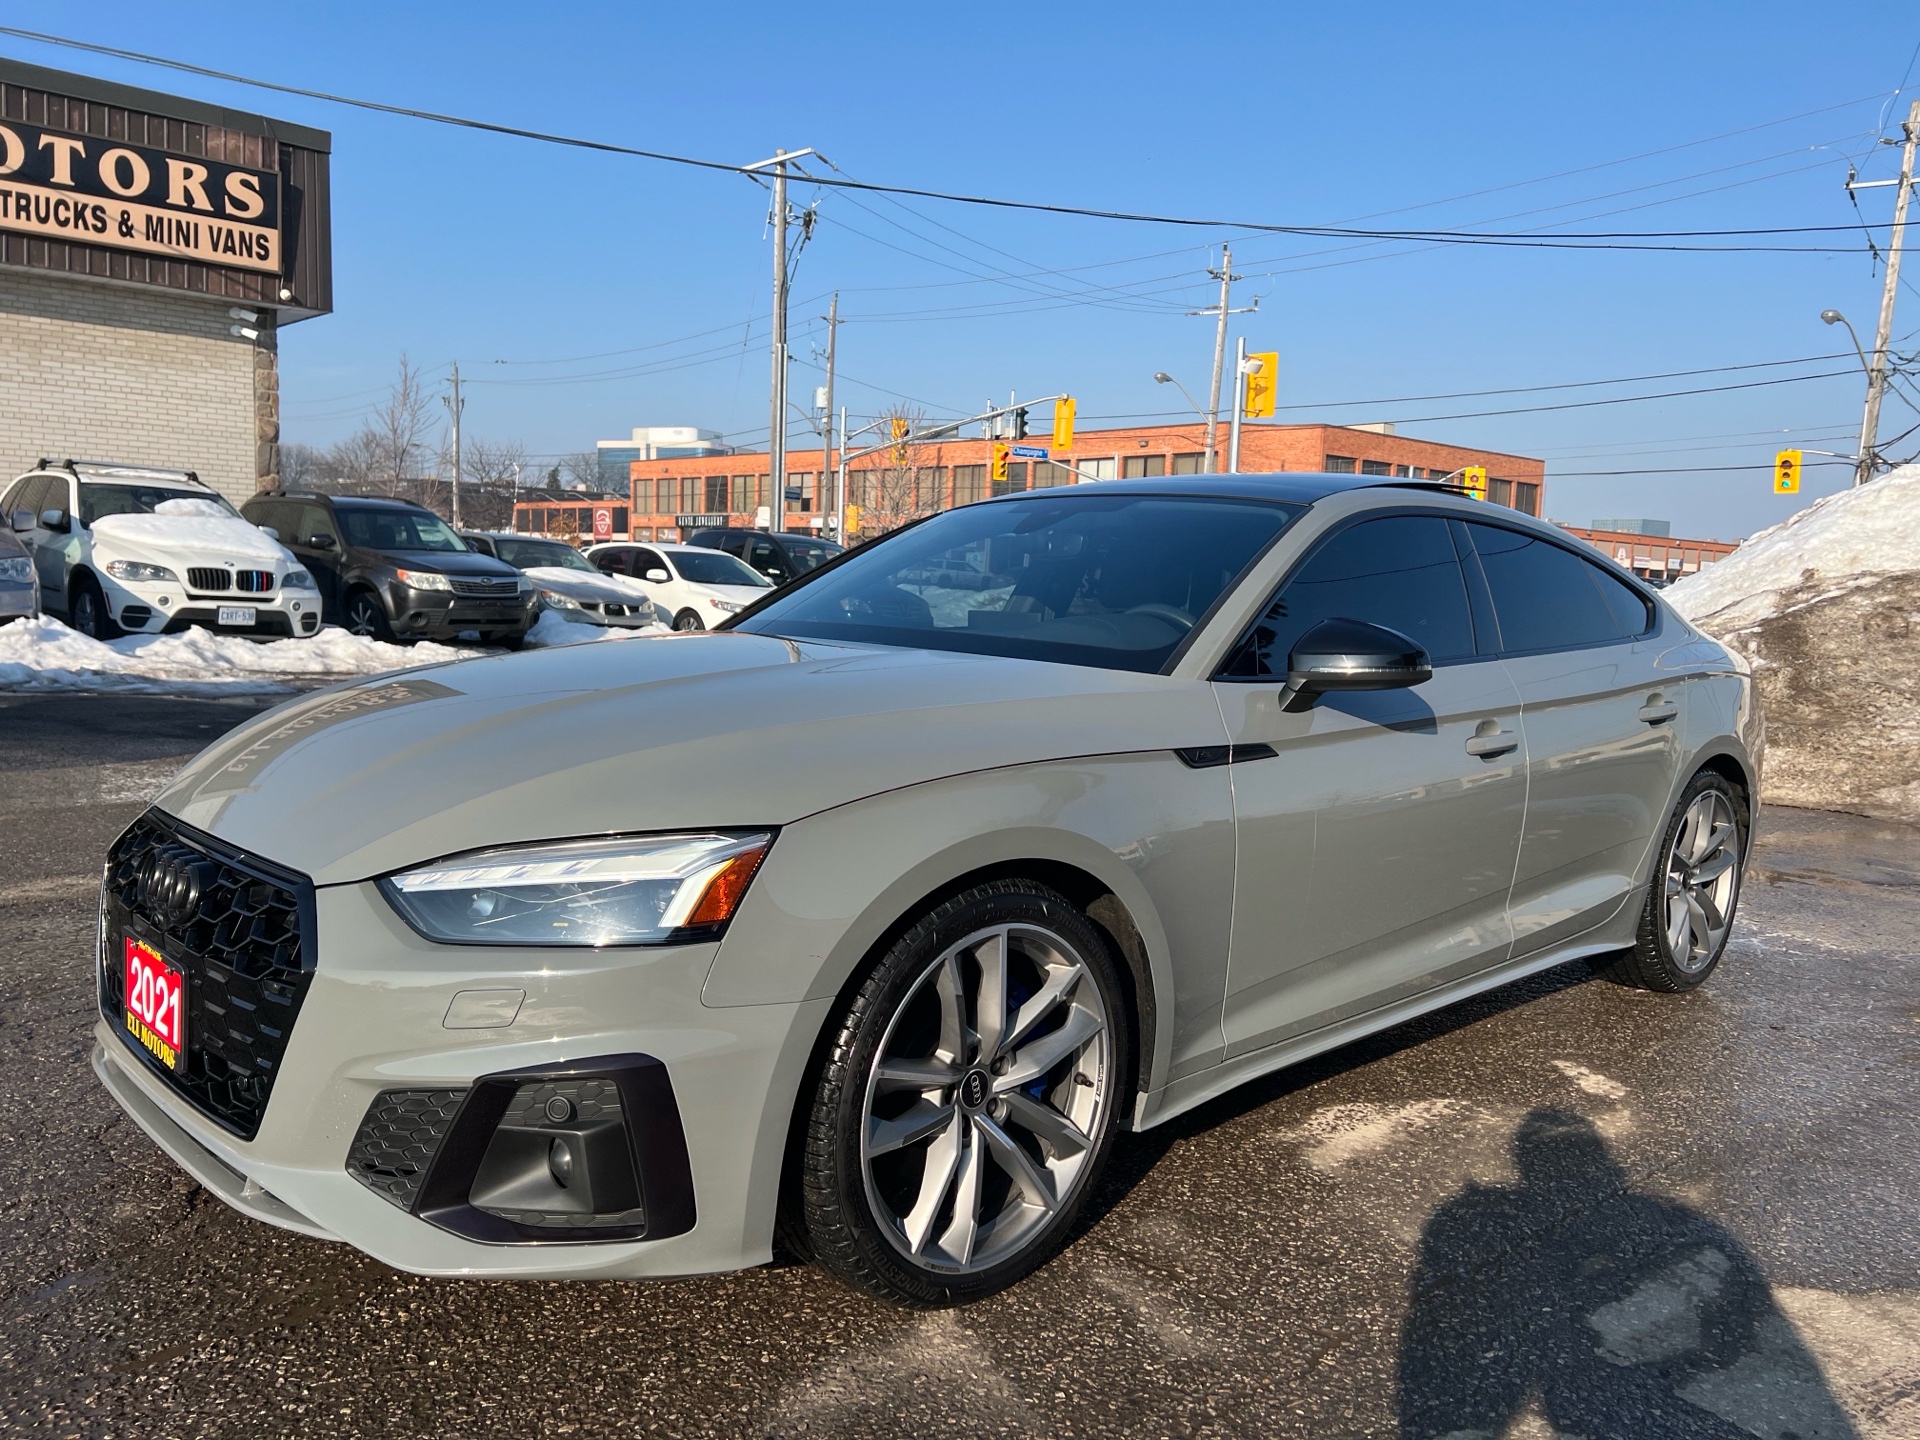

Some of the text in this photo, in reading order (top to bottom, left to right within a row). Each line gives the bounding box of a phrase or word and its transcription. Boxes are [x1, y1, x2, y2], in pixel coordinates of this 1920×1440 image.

[0, 189, 270, 261] TRUCKS & MINI VANS
[131, 956, 179, 1045] 2021
[127, 1011, 176, 1070] ELI MOTORS
[865, 1239, 940, 1301] BRIDGESTONE
